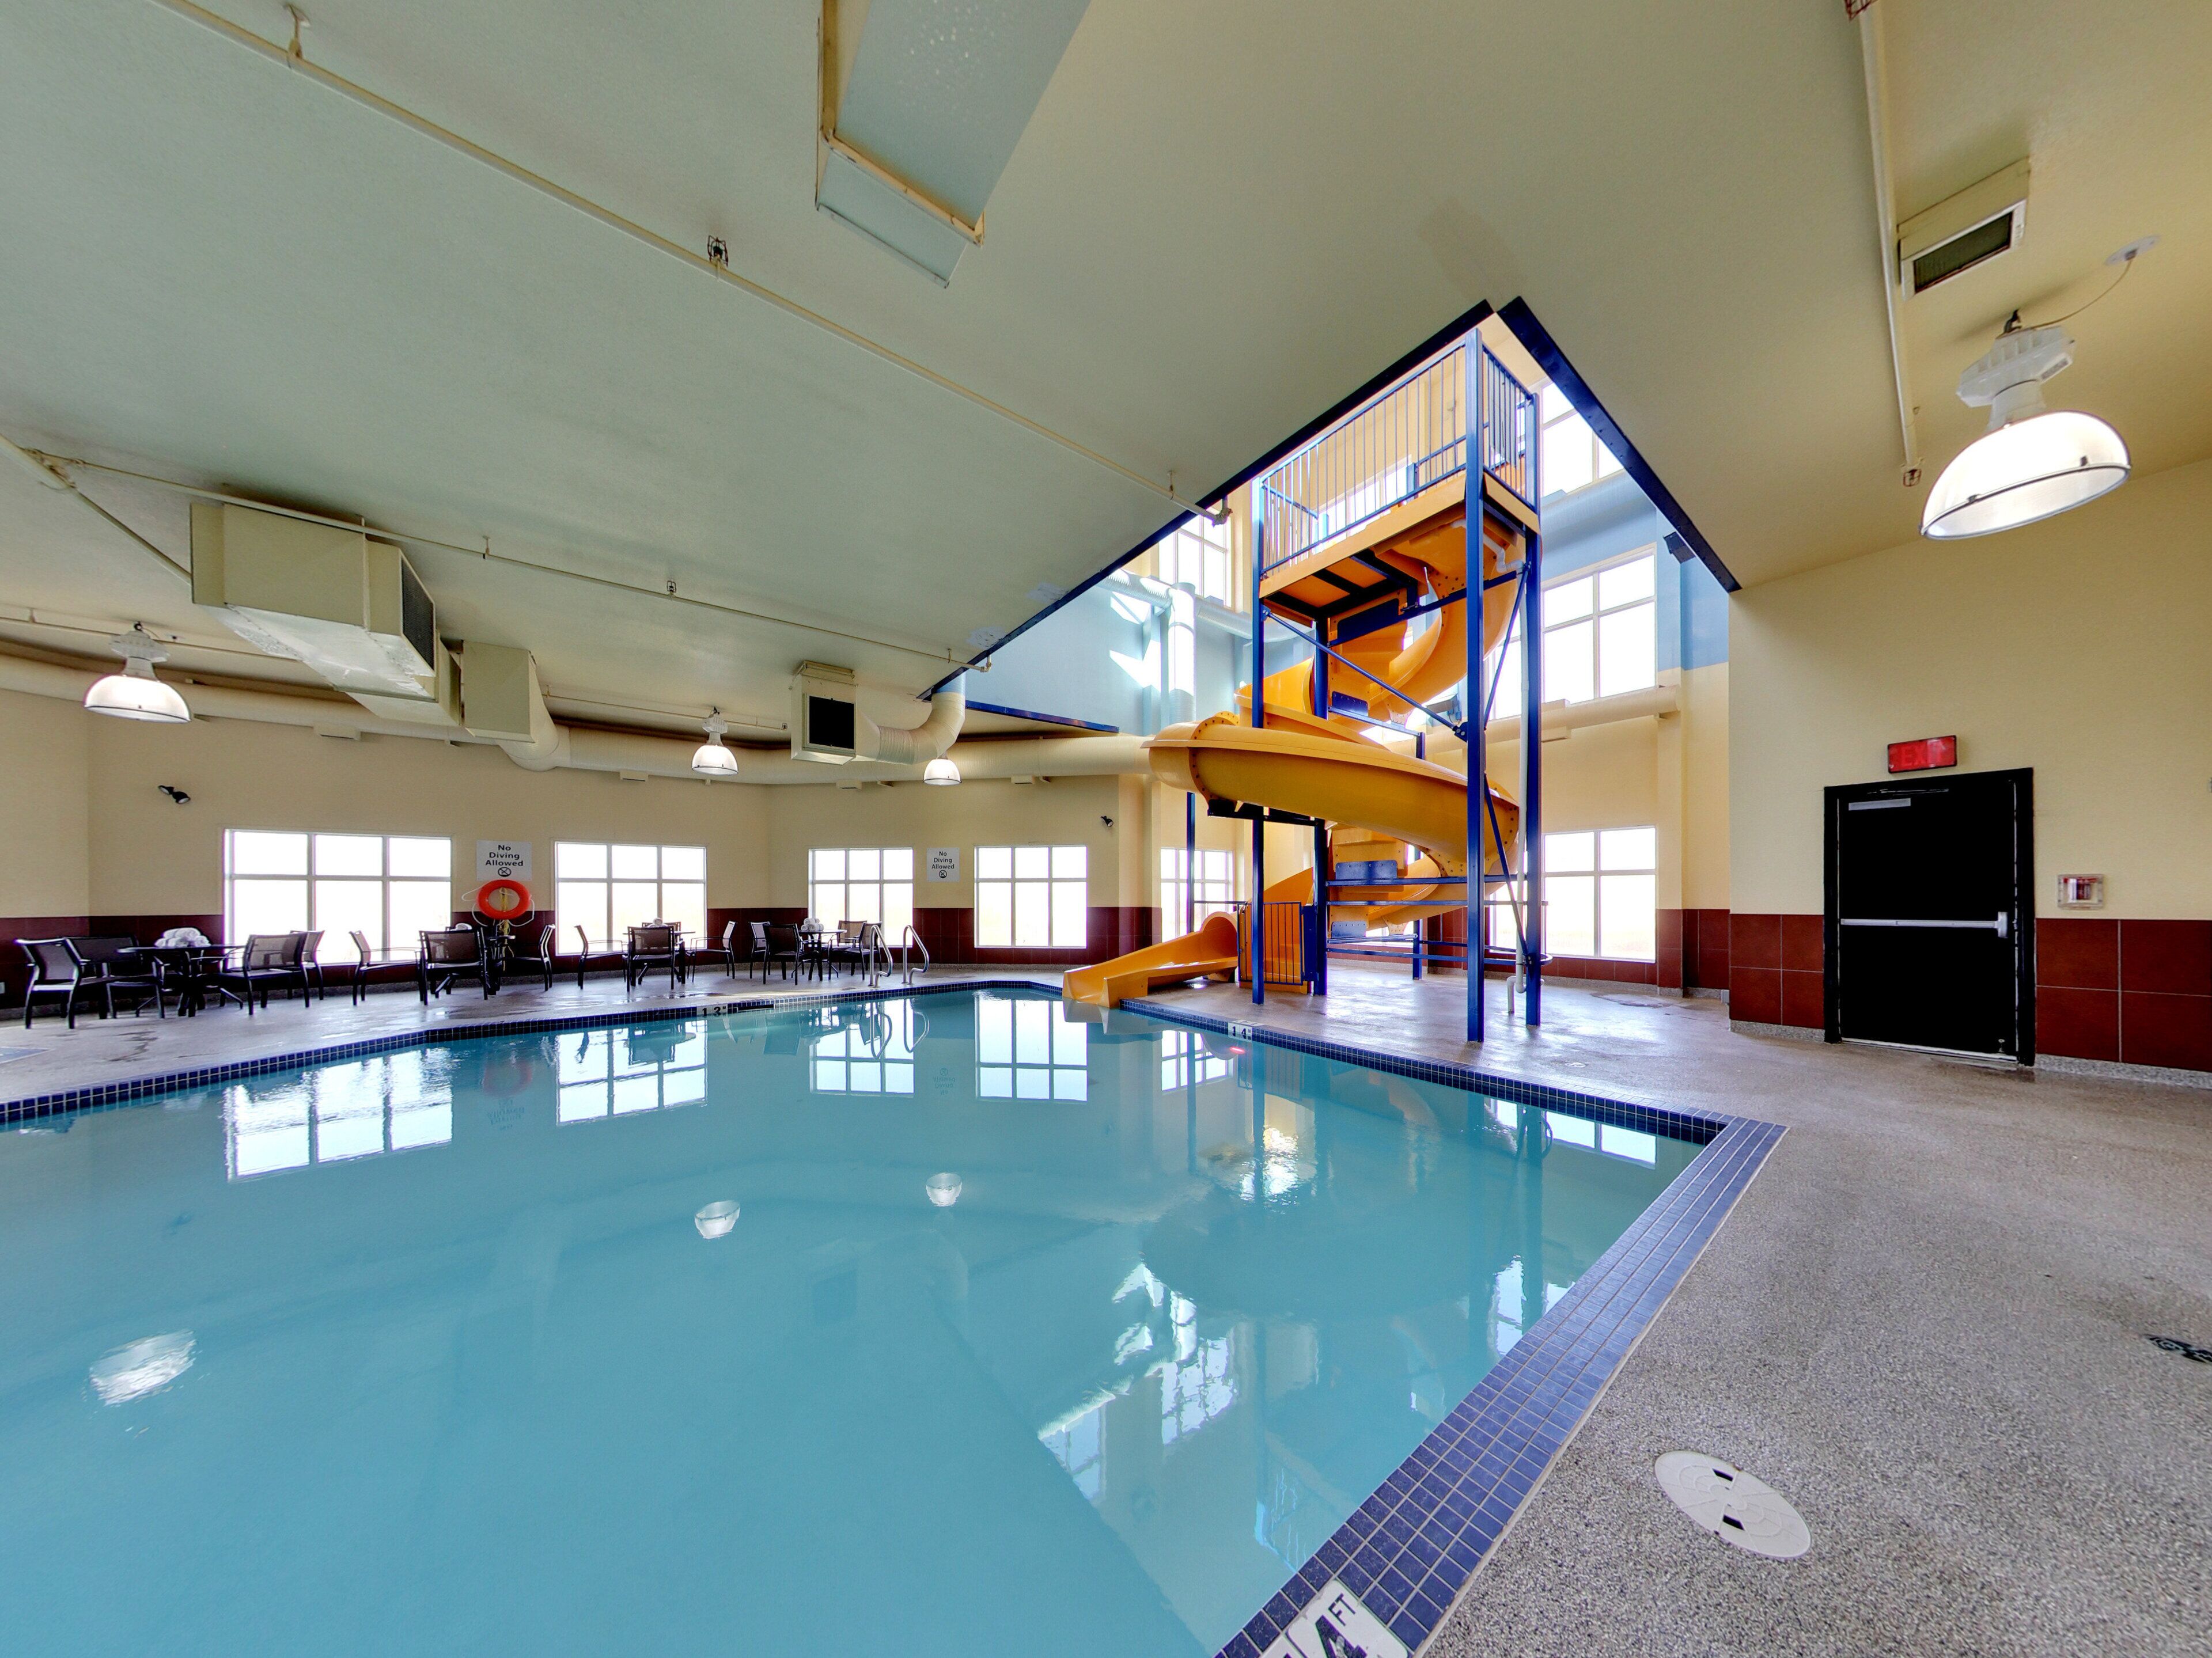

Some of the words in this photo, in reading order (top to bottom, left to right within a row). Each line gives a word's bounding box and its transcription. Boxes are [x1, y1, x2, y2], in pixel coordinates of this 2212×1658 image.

[1901, 741, 1945, 767] EXIT
[489, 852, 520, 860] Diving
[1328, 1593, 1356, 1626] FT
